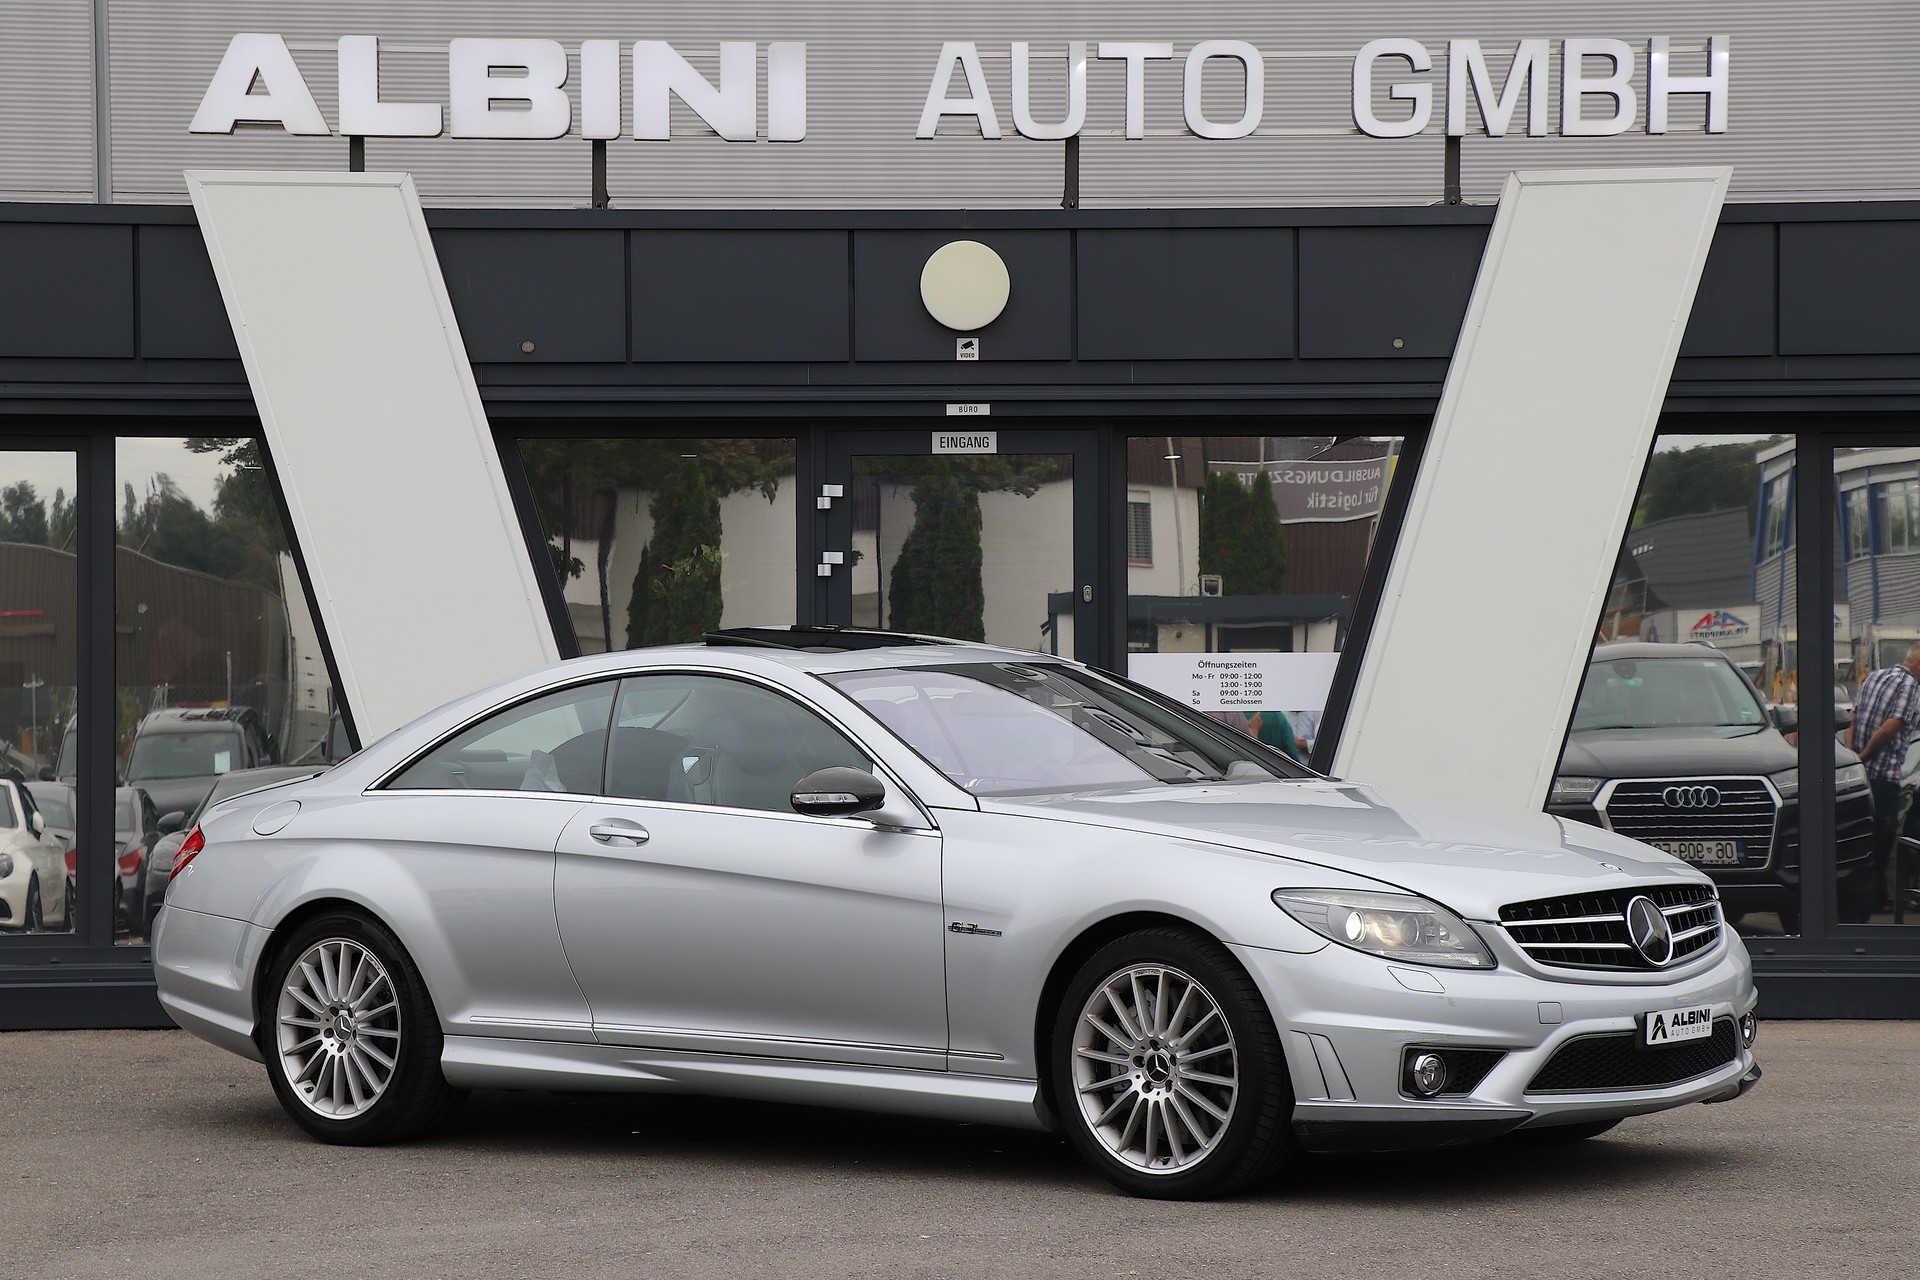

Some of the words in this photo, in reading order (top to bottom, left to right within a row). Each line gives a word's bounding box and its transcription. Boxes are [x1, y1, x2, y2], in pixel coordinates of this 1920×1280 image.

[188, 32, 807, 143] ALBINI
[915, 38, 1265, 141] AUTO
[1351, 35, 1731, 138] GMBH
[958, 405, 978, 413] BÜRO
[940, 436, 990, 448] EINGANG
[1198, 660, 1257, 669] Öffnungszeiten
[1671, 1008, 1710, 1027] ALBINI
[1671, 1027, 1689, 1037] AUTO
[1692, 1025, 1710, 1034] GMBH
